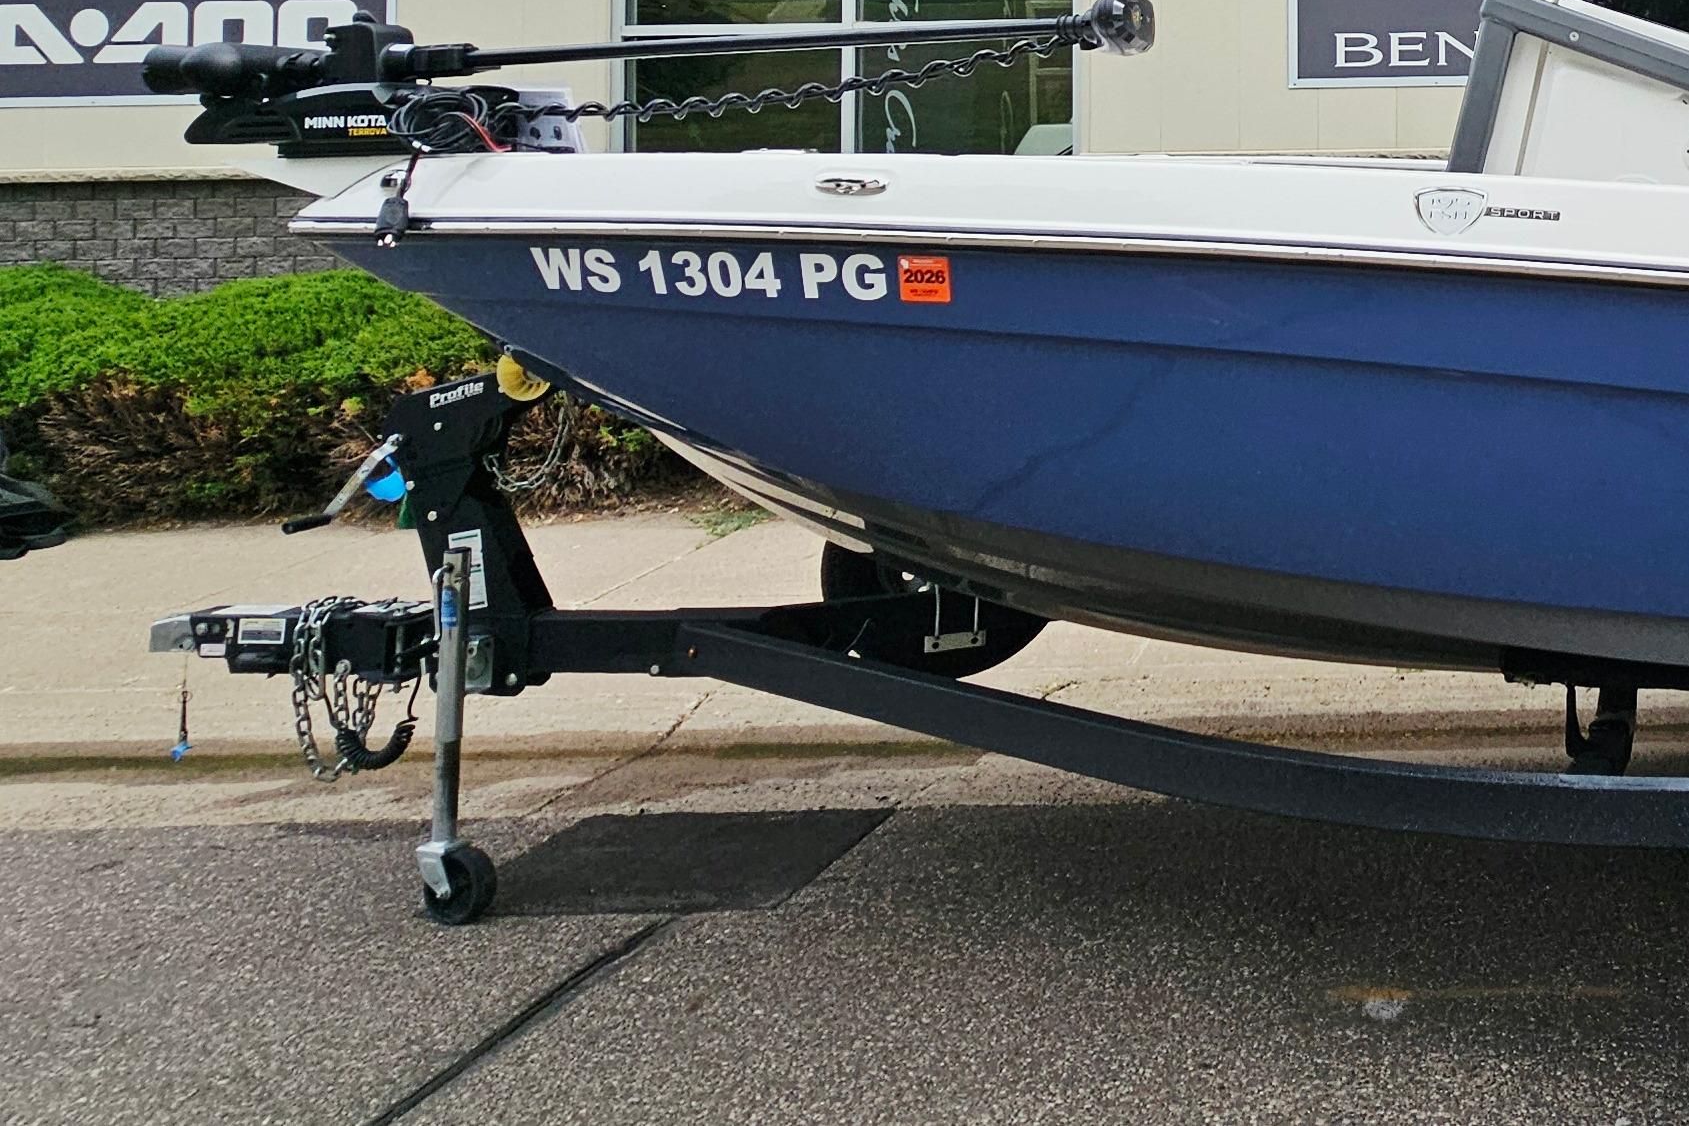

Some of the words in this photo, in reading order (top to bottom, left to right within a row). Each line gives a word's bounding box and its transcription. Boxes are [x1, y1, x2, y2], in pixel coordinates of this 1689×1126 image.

[304, 116, 345, 129] MINN
[347, 114, 387, 127] KOTA
[348, 127, 387, 137] TERROVA
[1490, 207, 1559, 220] SPORT
[530, 247, 621, 293] WS
[639, 250, 781, 298] 1304
[800, 254, 888, 301] PG
[903, 269, 946, 285] 2026
[429, 382, 484, 408] Profile
